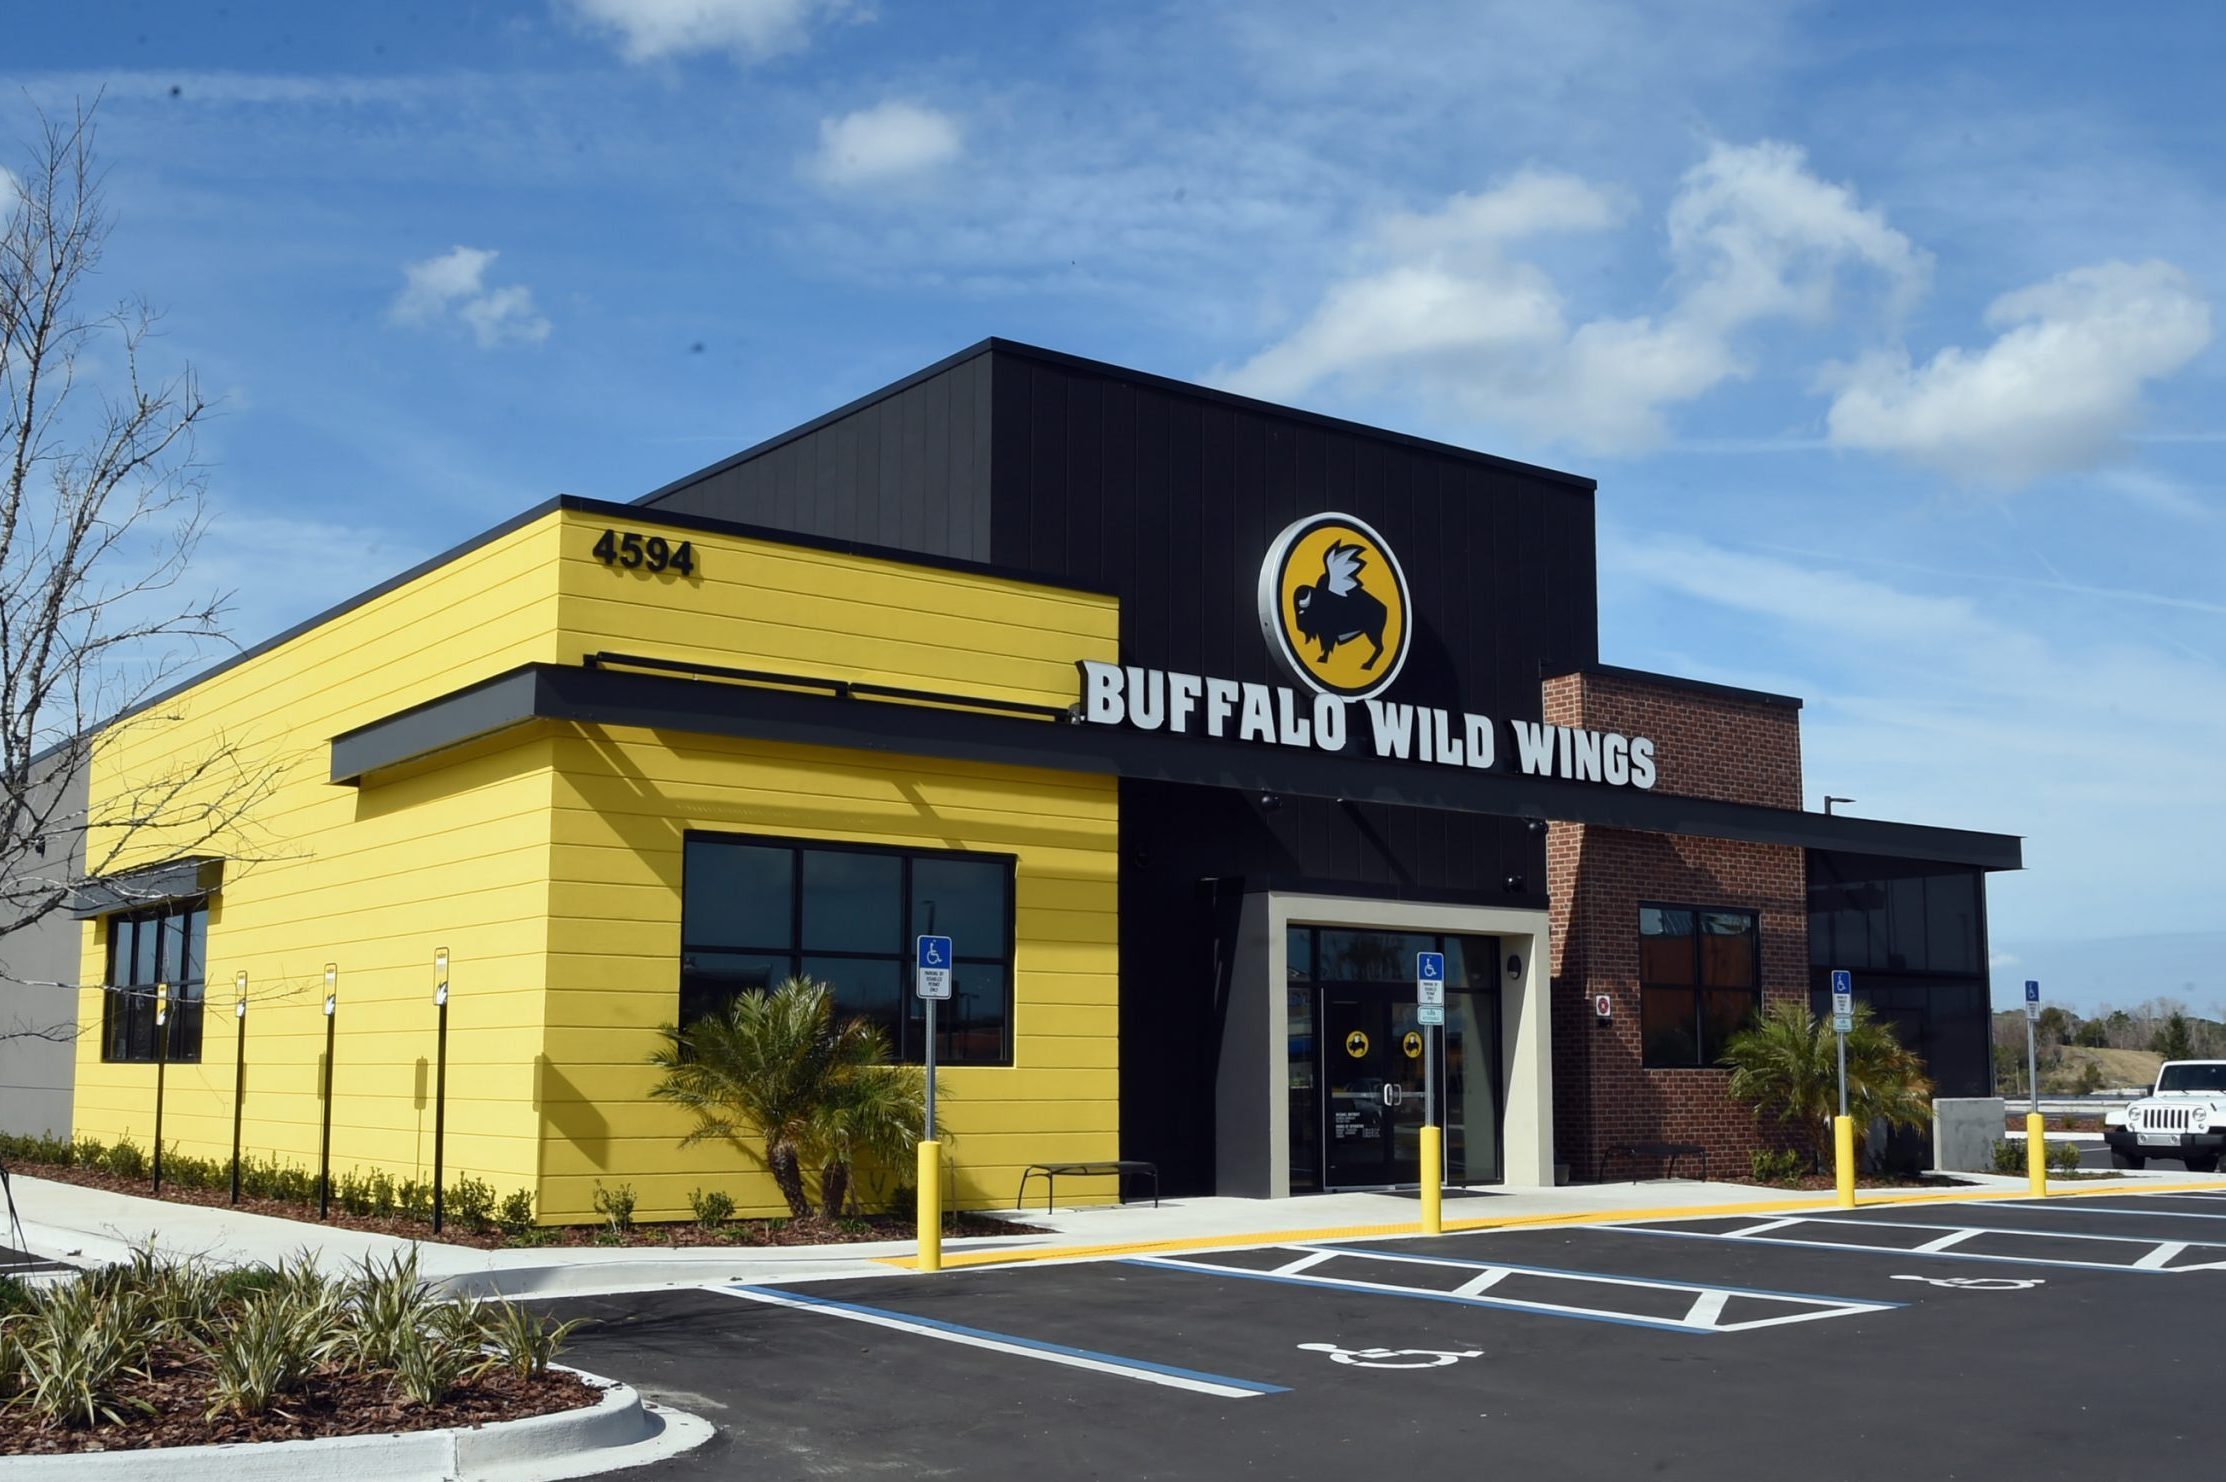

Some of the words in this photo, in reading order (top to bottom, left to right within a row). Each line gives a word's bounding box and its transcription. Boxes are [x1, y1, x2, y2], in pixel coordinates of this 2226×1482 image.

[592, 528, 694, 576] 4594
[1082, 659, 1348, 752] BUFFALO
[1366, 699, 1495, 769] WILD
[1510, 719, 1657, 790] WINGS
